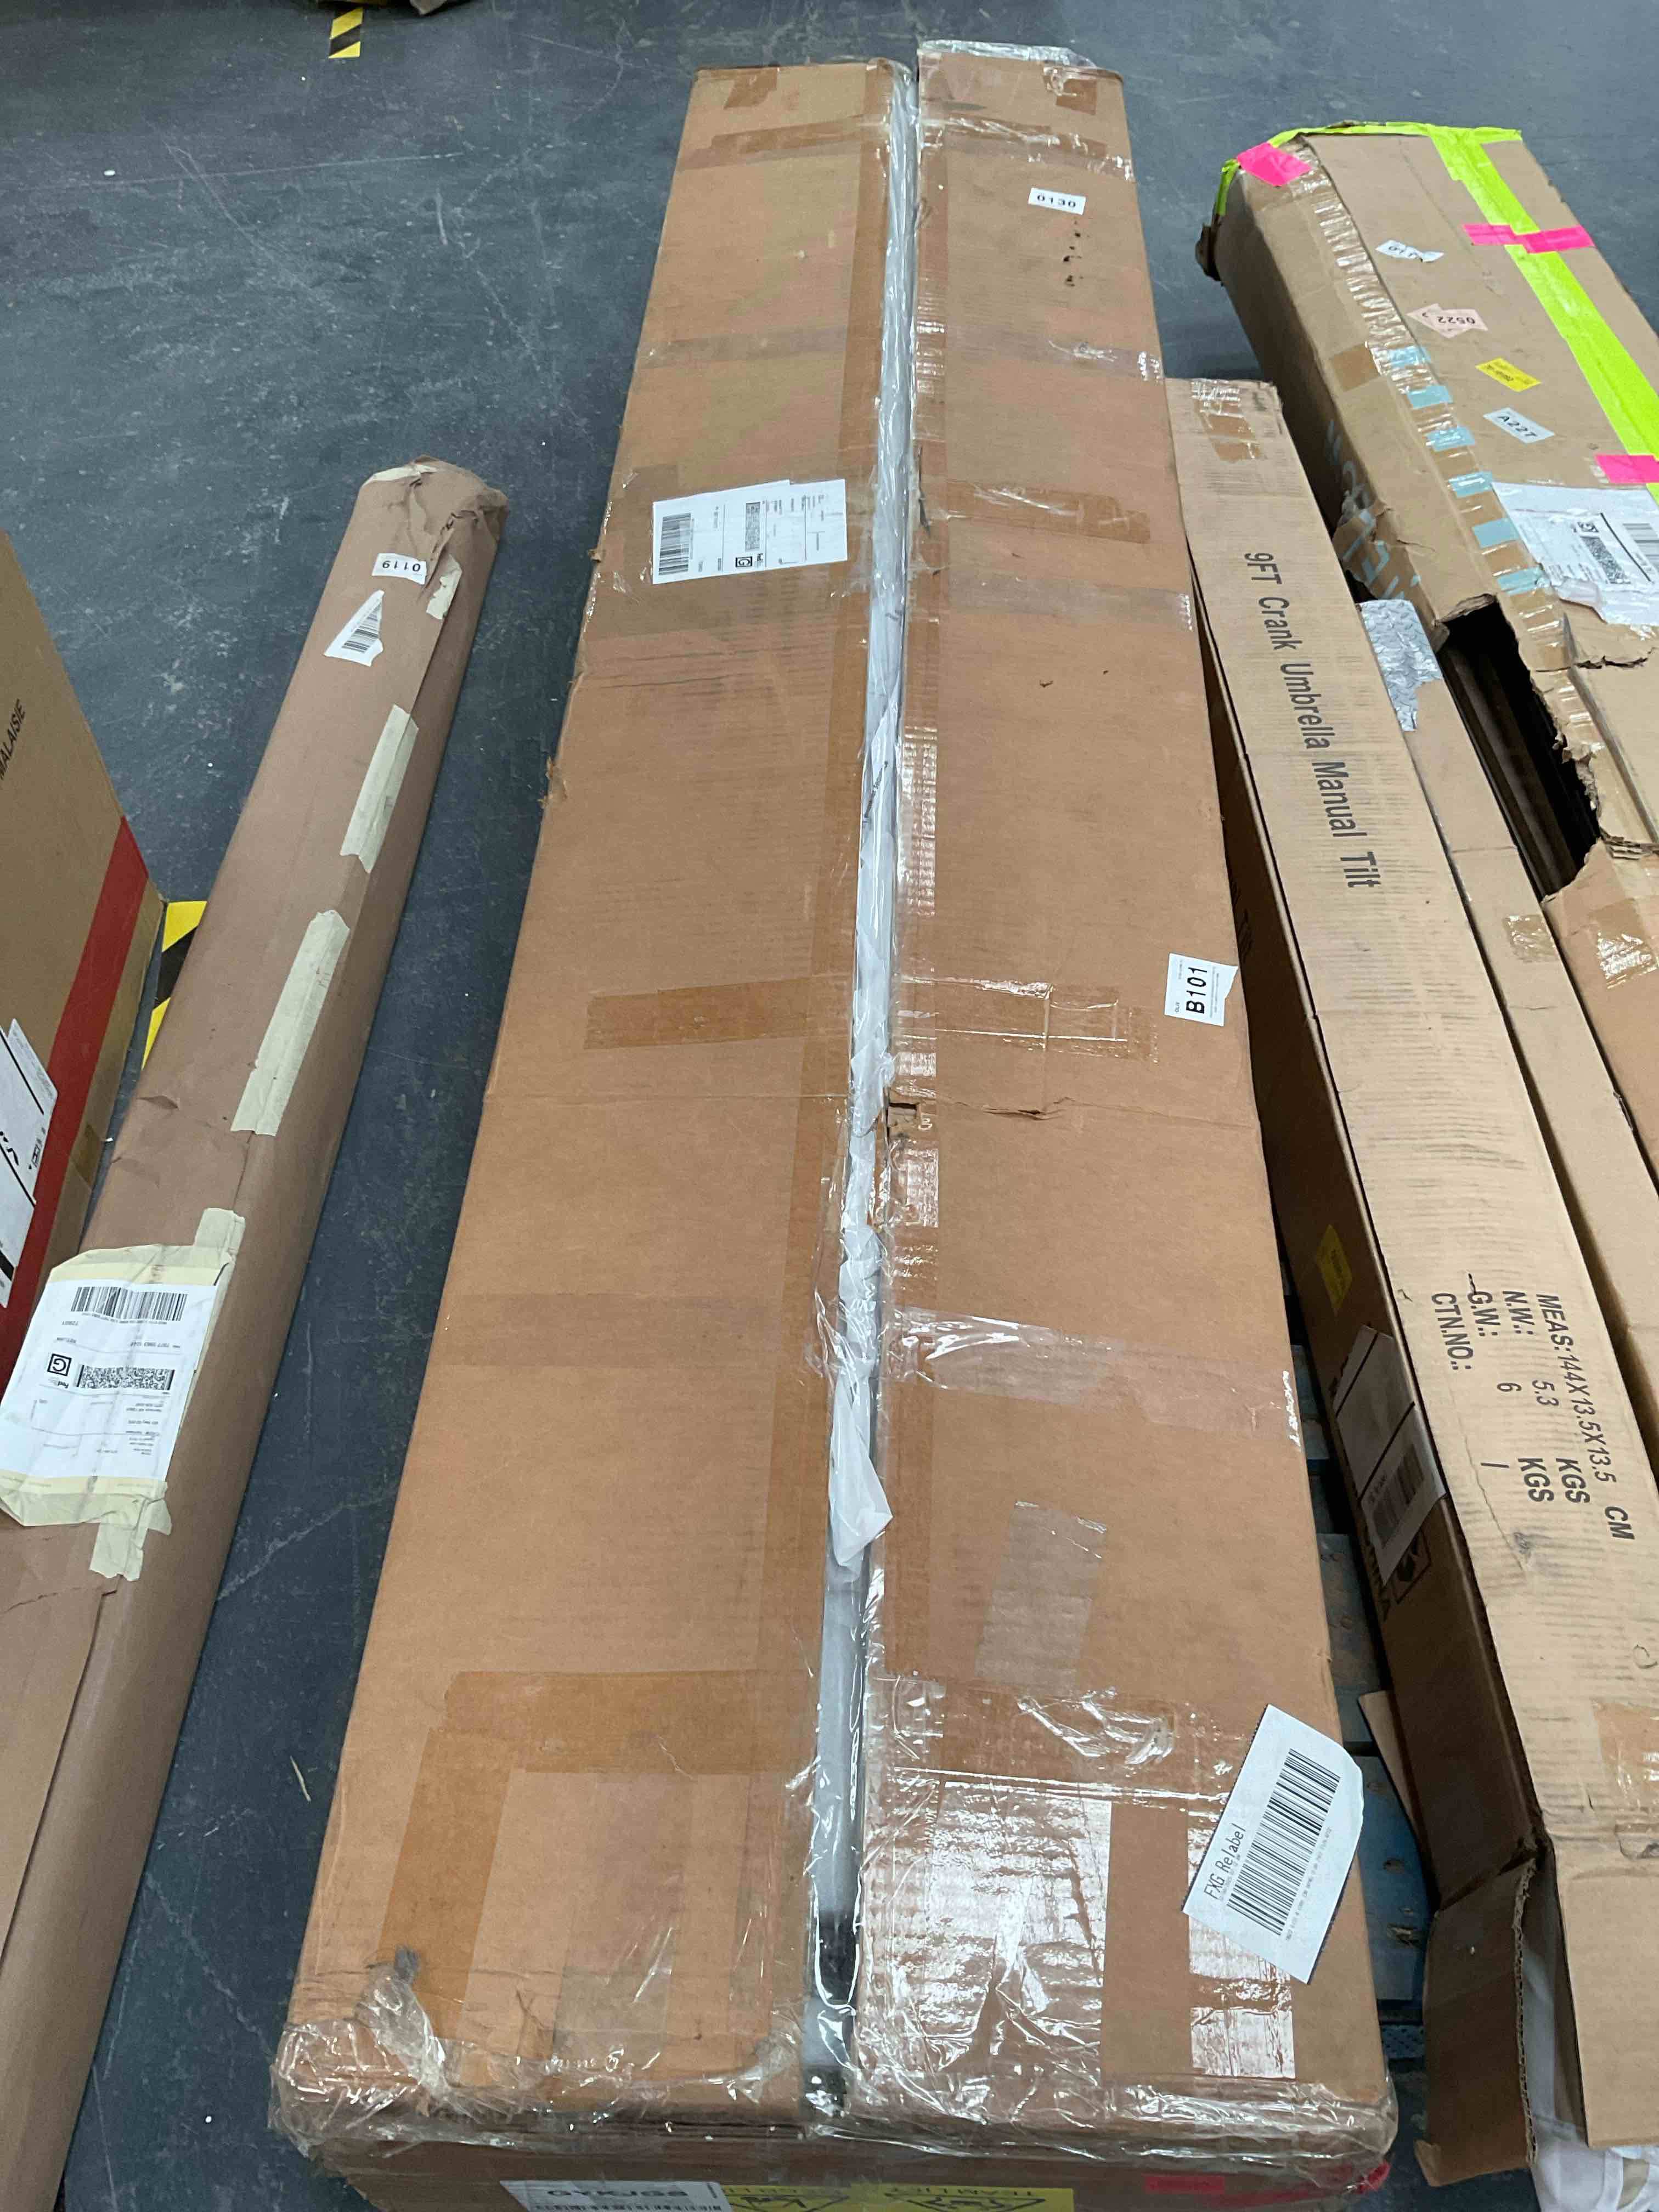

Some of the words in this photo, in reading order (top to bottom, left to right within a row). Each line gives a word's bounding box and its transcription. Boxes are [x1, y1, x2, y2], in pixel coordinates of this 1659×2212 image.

[1437, 316, 1476, 325] 0522
[1244, 552, 1283, 585] 9FT
[1258, 596, 1304, 651] Crank
[1280, 662, 1335, 750] Umbrella
[1311, 760, 1368, 838] Manual
[1340, 850, 1382, 889] Tilt
[1186, 967, 1207, 1014] B101
[1502, 1290, 1535, 1335] N.W.:
[1532, 1379, 1560, 1406] 5.3
[1555, 1457, 1591, 1504] KGS
[1496, 1382, 1522, 1392] 6
[1517, 1457, 1555, 1503] KGS
[1604, 1505, 1635, 1541] CM
[1204, 1872, 1224, 1900] FXG
[1215, 1822, 1247, 1875] Relabel
